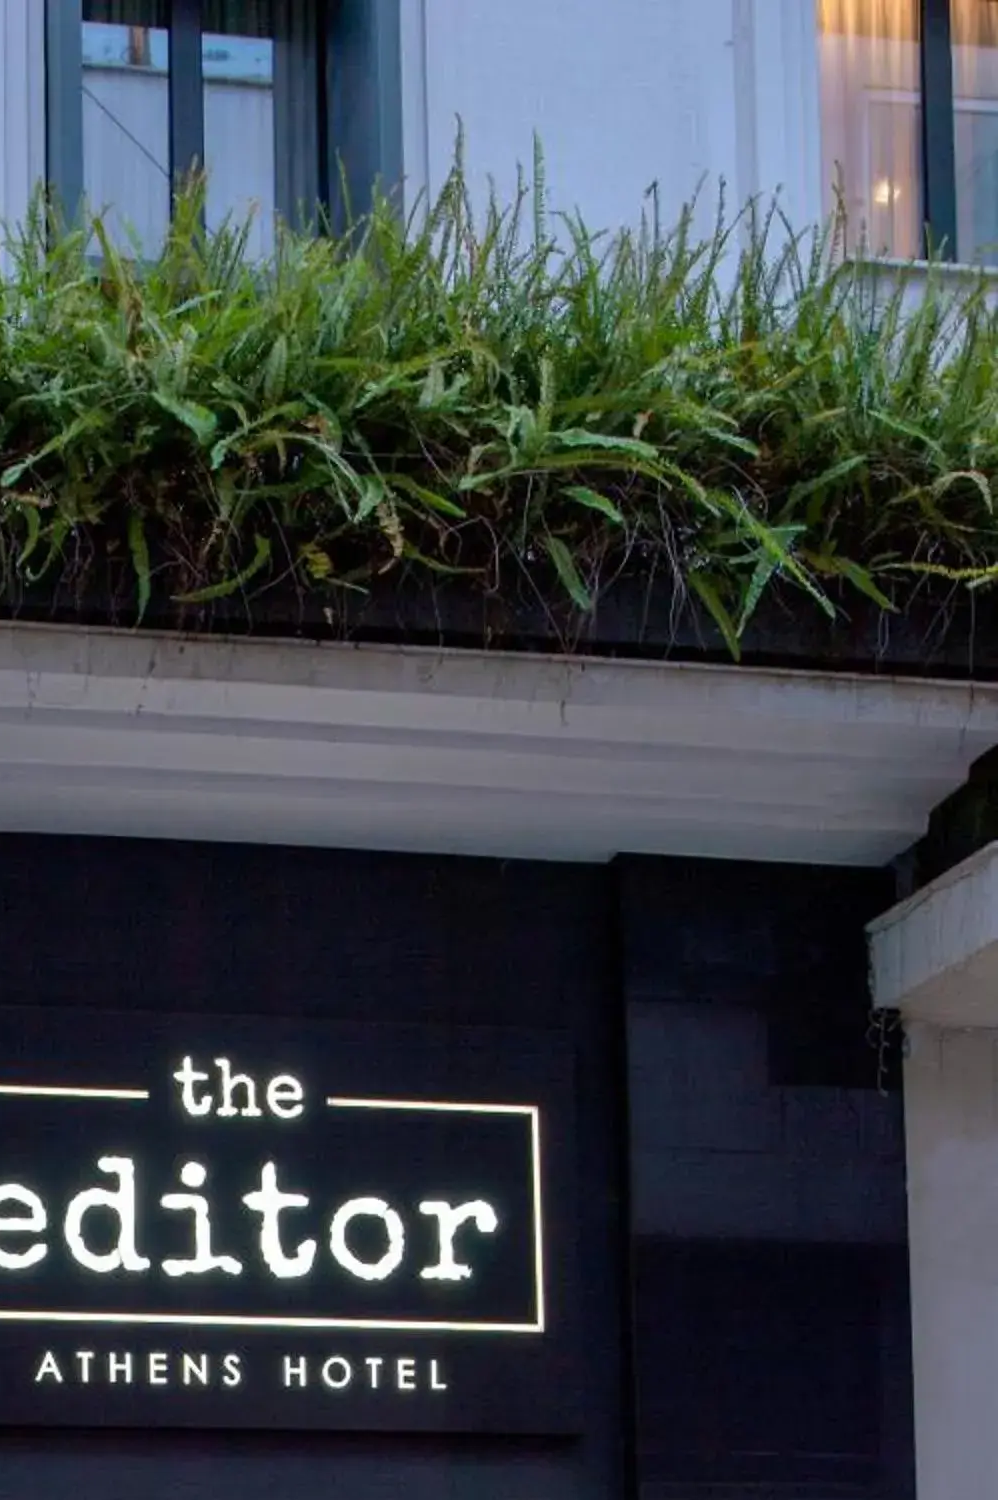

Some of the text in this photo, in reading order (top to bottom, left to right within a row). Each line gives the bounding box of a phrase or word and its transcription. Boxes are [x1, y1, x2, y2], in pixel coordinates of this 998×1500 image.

[173, 1056, 304, 1118] the
[35, 1350, 448, 1390] ATHENS HOTEL
